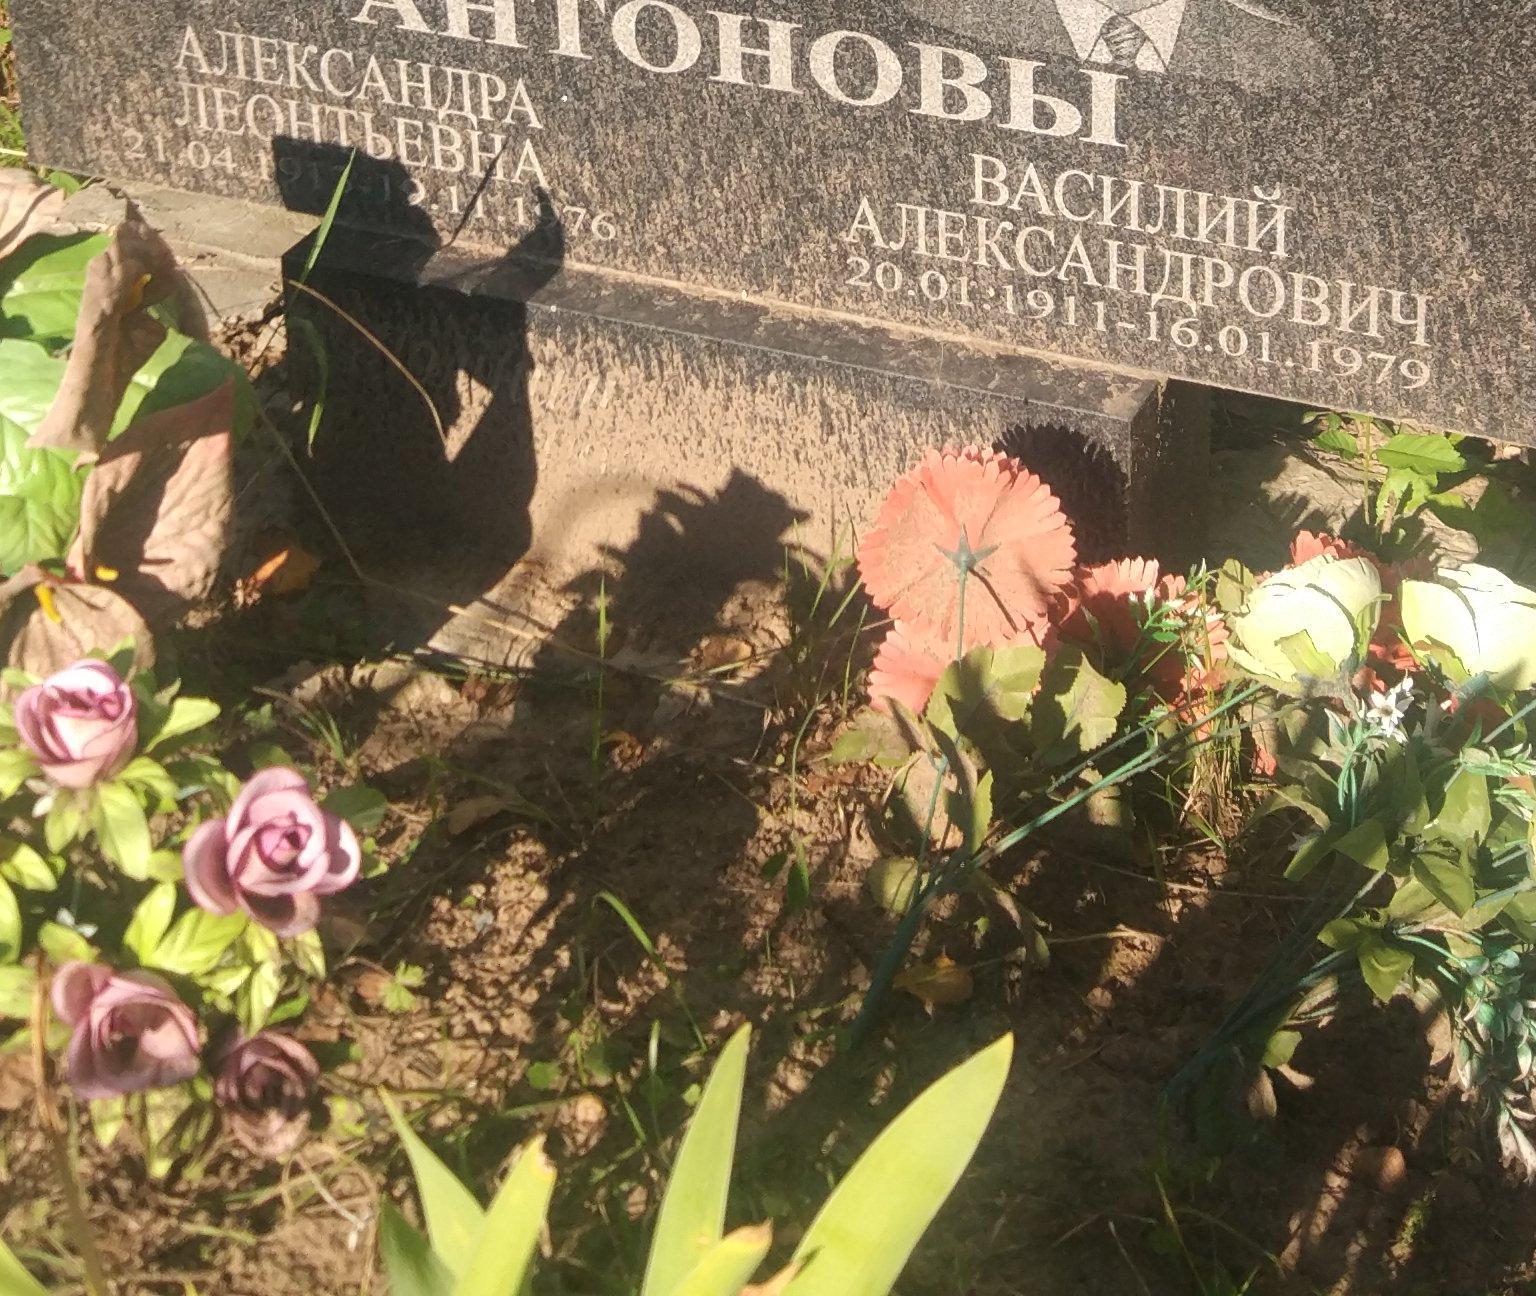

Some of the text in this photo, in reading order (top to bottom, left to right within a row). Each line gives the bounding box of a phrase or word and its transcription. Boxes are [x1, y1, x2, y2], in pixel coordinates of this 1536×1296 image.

[174, 25, 544, 131] АЛЕКСАНДРА
[175, 82, 550, 189] ЛЕОНТЬЕВНА
[970, 152, 1292, 259] ВАСИЛИЙ
[845, 195, 1434, 347] АЛЕКСАНДРОВИЧ
